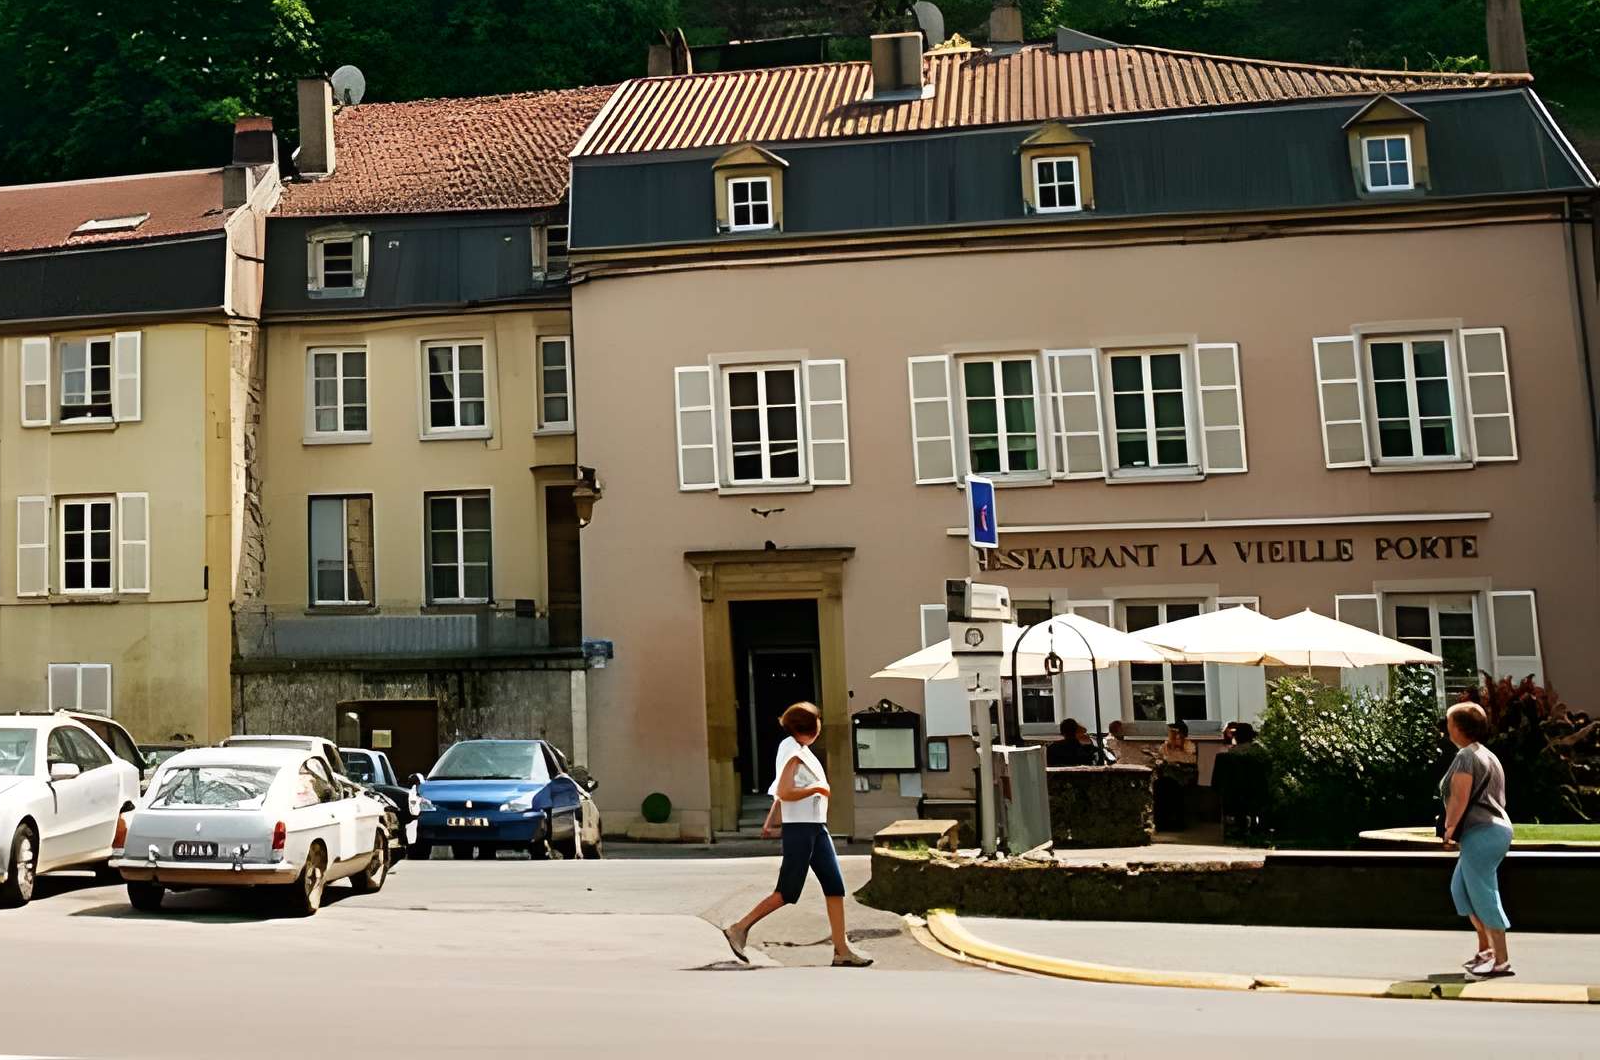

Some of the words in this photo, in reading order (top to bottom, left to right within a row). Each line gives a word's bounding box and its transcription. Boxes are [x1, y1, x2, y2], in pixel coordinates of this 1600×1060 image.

[1180, 543, 1217, 566] LA
[1233, 539, 1354, 564] VIEILLE
[1375, 535, 1479, 561] PORTE
